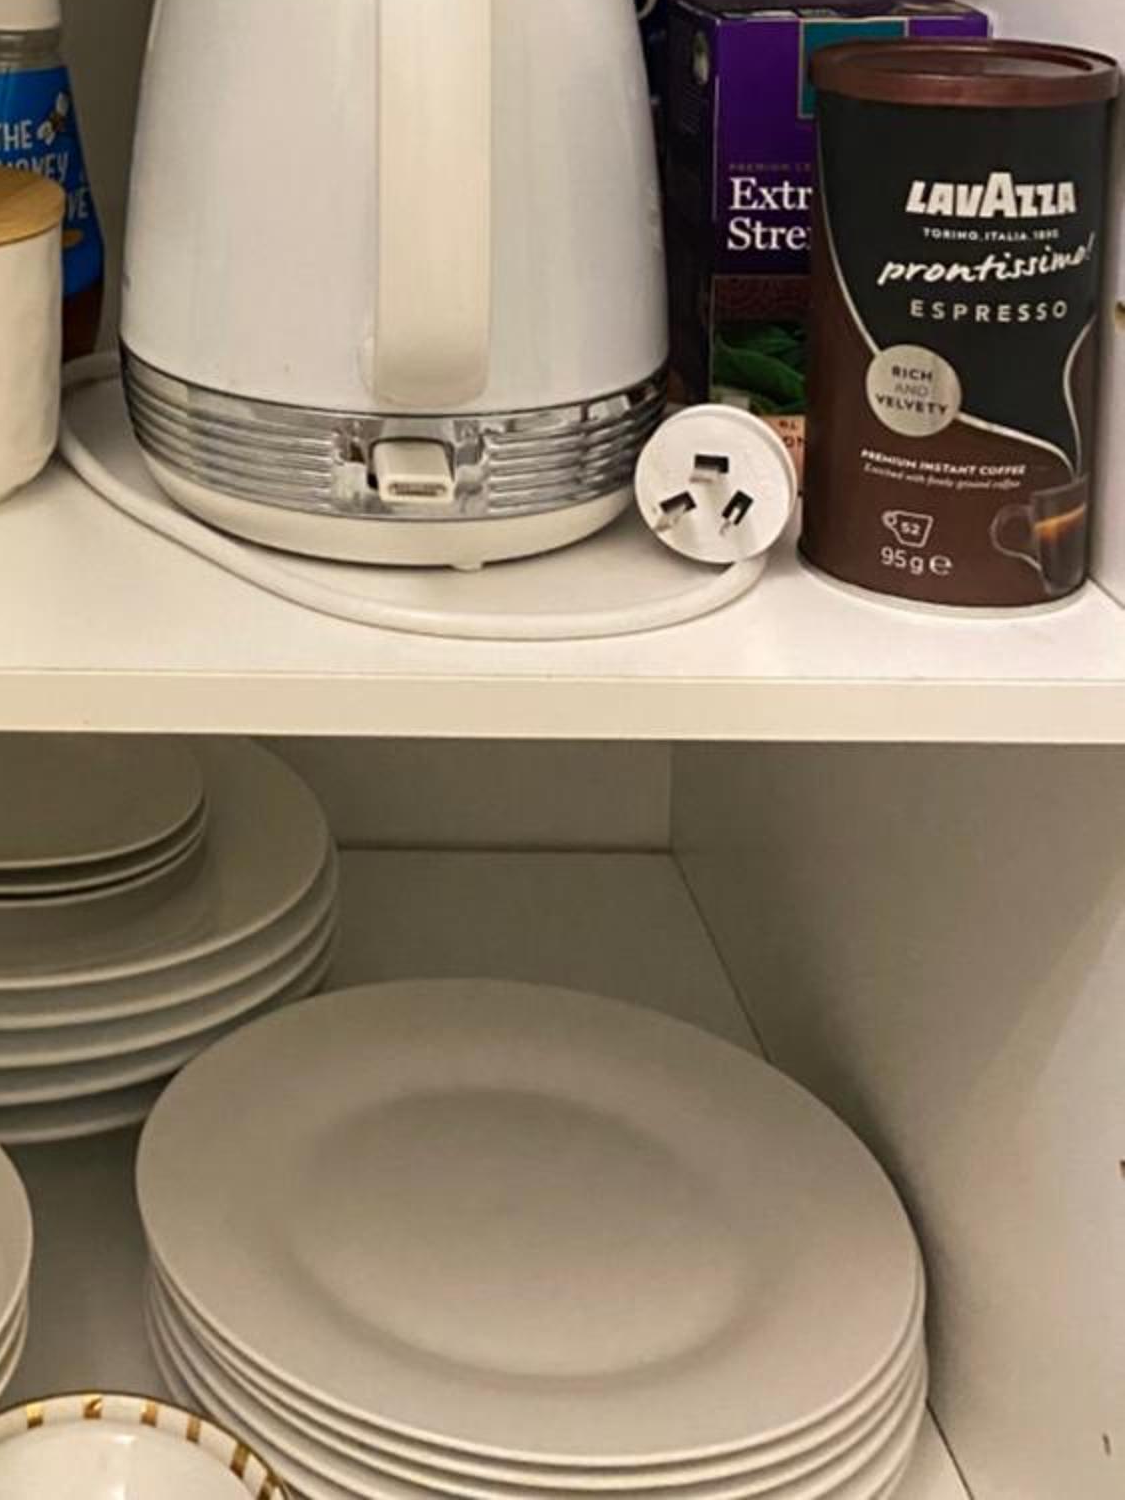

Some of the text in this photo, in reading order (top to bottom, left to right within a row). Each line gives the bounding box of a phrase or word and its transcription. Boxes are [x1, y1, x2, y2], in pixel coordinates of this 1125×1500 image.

[728, 175, 814, 211] Extr
[905, 171, 1076, 219] LAVAZZA
[726, 216, 812, 251] Stre
[910, 299, 1068, 322] ESPRESSO
[891, 365, 933, 382] RICH
[894, 381, 929, 397] AND
[875, 393, 949, 416] VELVETY
[860, 449, 1026, 476] PREMIUM INSTANT COFFEE
[900, 520, 921, 536] 52
